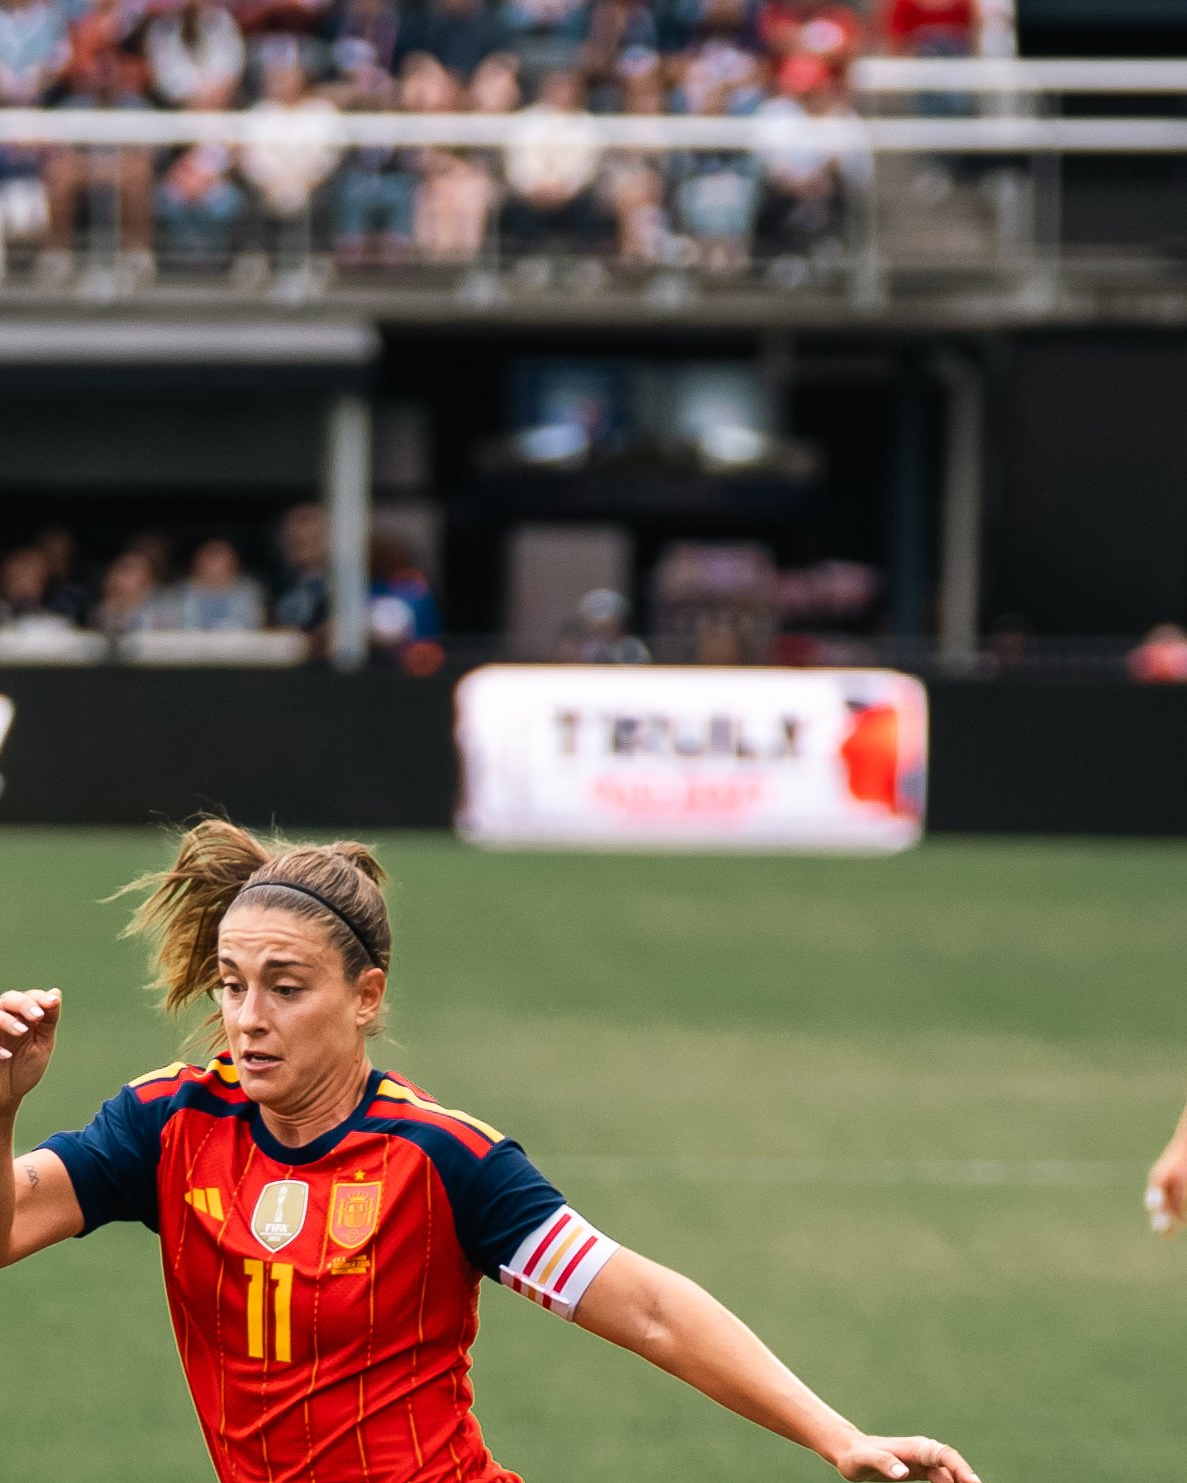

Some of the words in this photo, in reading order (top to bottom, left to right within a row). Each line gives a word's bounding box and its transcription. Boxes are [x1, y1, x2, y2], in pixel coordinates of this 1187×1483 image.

[555, 707, 804, 759] TRULY
[264, 1222, 288, 1233] FIFA
[243, 1257, 294, 1363] 11
